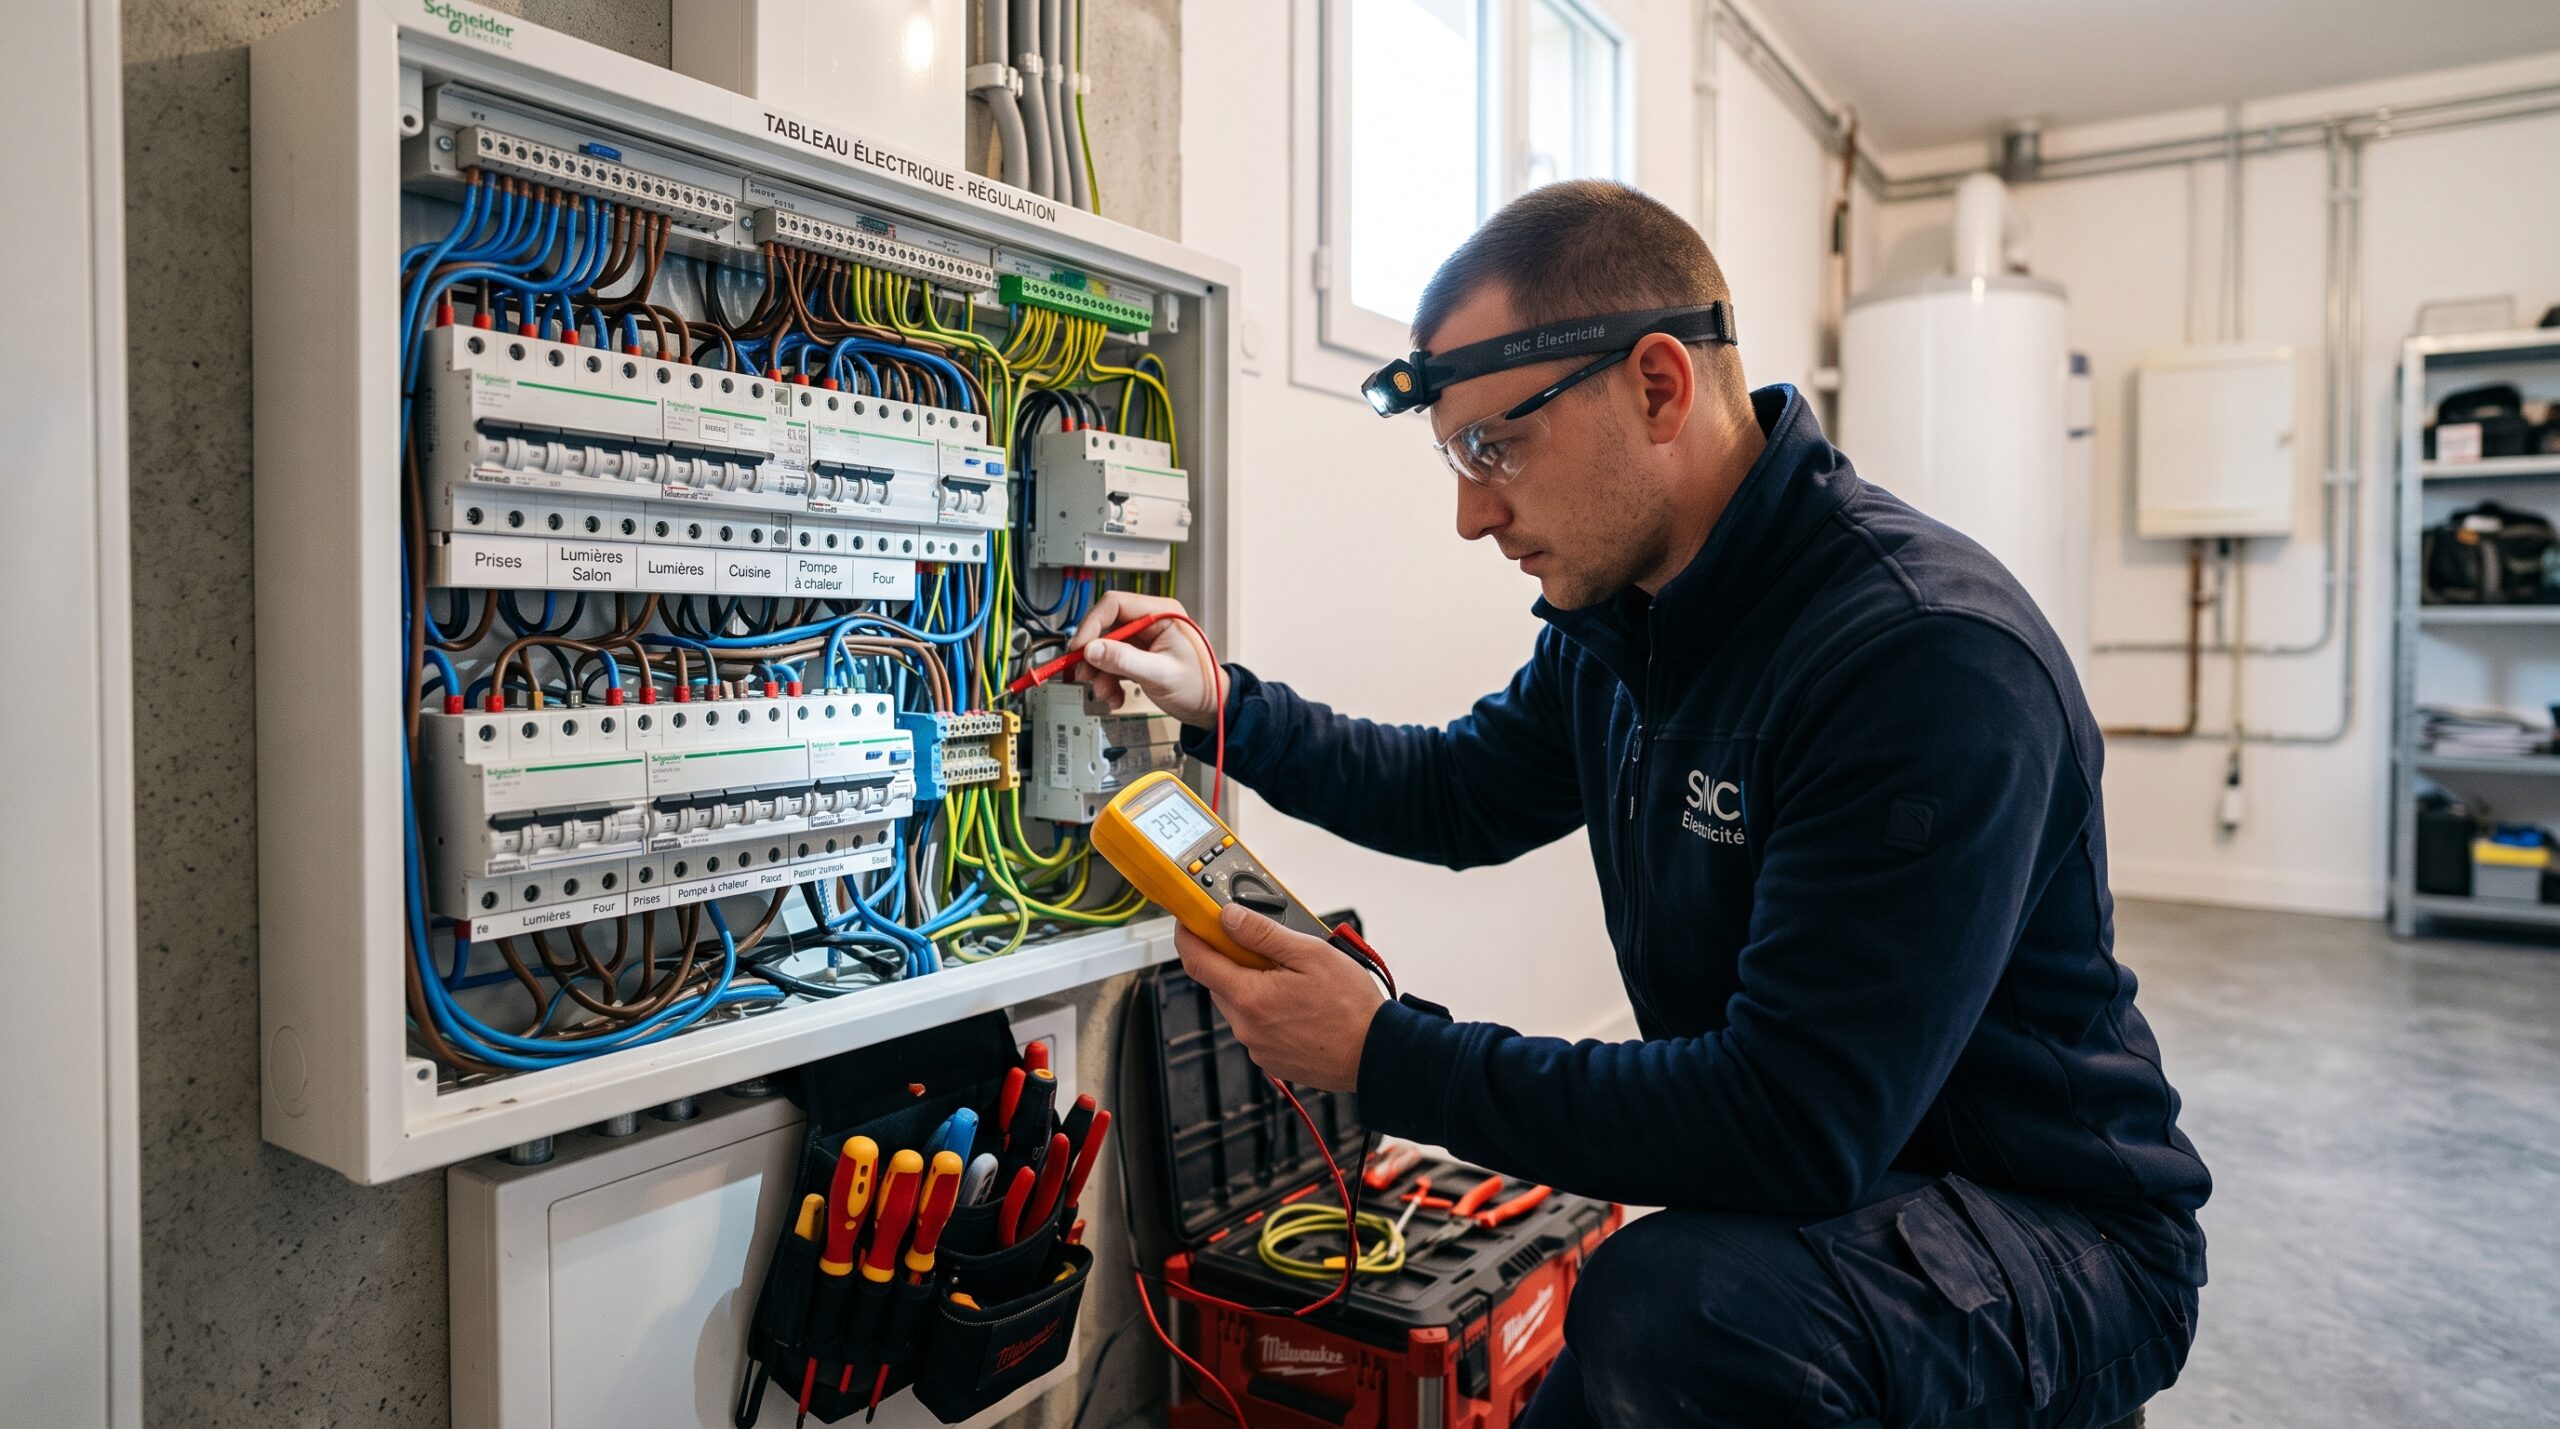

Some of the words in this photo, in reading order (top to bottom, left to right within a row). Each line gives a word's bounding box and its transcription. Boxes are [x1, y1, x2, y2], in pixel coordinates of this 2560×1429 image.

[423, 0, 514, 37] Schneider
[464, 27, 513, 50] Electric
[764, 112, 848, 156] TABLEAU
[854, 139, 955, 191] ÉLECTRIQUE
[968, 180, 1056, 223] RÉGULATION
[1503, 339, 1531, 356] SNC
[1536, 324, 1606, 348] Électricité
[475, 551, 522, 568] Prises
[560, 546, 623, 563] Lumières
[572, 567, 612, 582] Salon
[648, 560, 704, 576] Lumières
[728, 564, 771, 579] Cuisine
[799, 560, 838, 575] Pompe
[794, 577, 802, 589] à
[804, 578, 843, 591] chaleur
[872, 572, 895, 585] Four
[1685, 769, 1741, 821] SNC
[1151, 807, 1190, 840] 234
[522, 910, 571, 926] Lumières
[593, 902, 616, 914] Four
[633, 894, 661, 906] Prises
[678, 886, 708, 898] Pompe
[710, 883, 716, 893] à
[718, 879, 749, 891] chaleur
[1258, 1334, 1344, 1364] Milwaukee
